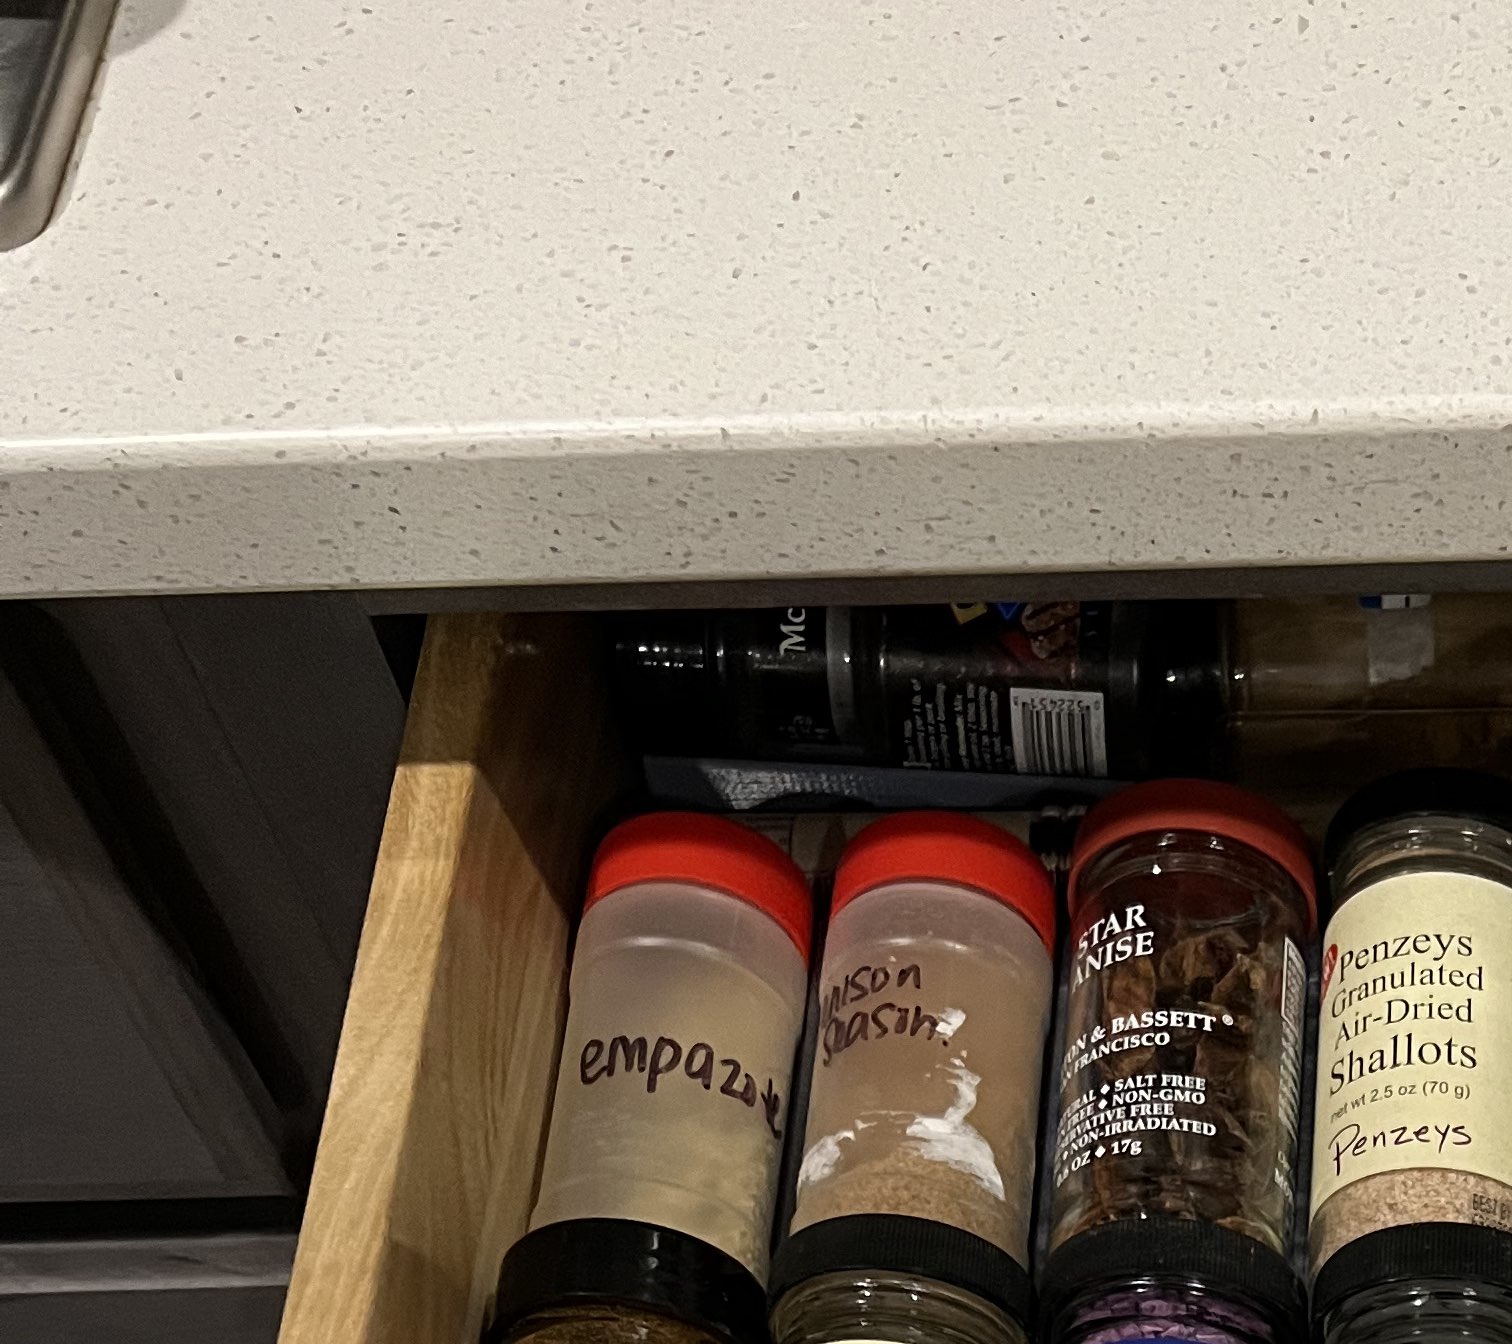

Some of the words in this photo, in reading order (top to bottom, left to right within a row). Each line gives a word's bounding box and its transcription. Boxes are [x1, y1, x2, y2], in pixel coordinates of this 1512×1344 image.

[1078, 904, 1147, 959] STAR
[1339, 933, 1473, 985] Penzeys
[1071, 930, 1155, 994] ANISE
[1331, 962, 1485, 1019] Granulated
[1333, 997, 1473, 1054] Air-Dried
[1329, 1032, 1478, 1097] Shallots
[1328, 1122, 1473, 1177] Penzeys
